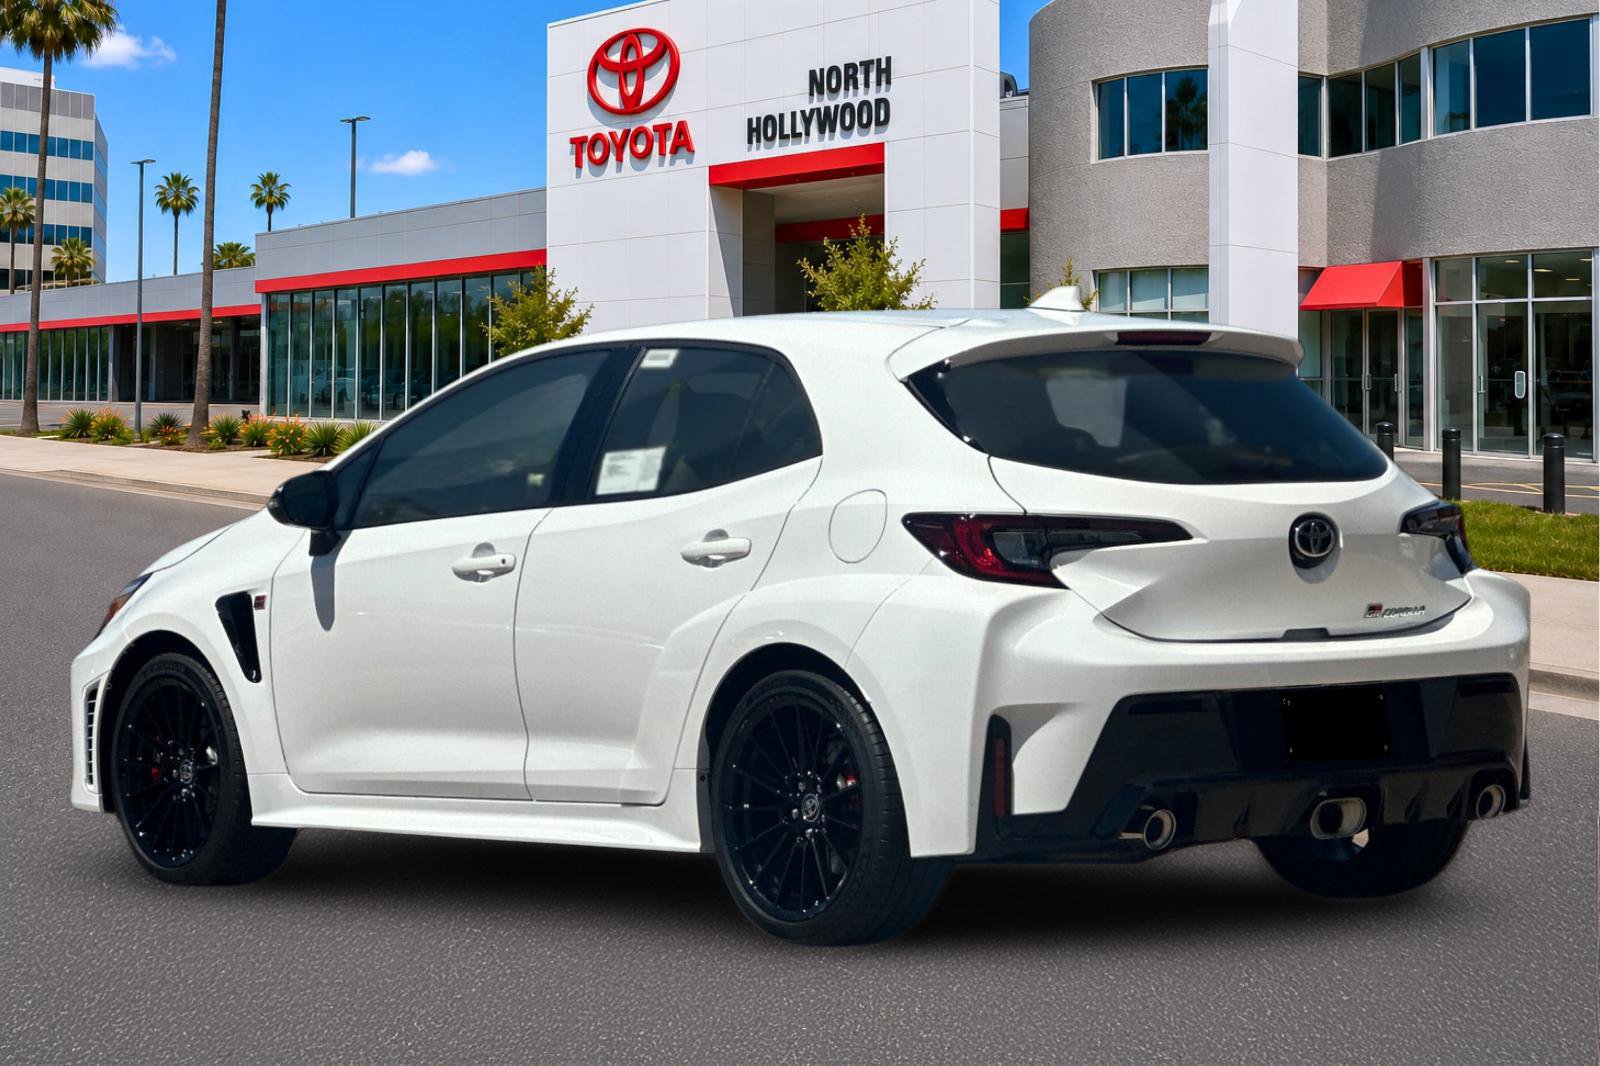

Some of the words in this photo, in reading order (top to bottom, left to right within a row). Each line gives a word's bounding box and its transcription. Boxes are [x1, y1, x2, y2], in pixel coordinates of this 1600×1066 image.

[808, 56, 892, 97] NORTH
[570, 121, 695, 169] TOYOTA
[747, 98, 891, 145] HOLLYWOOD
